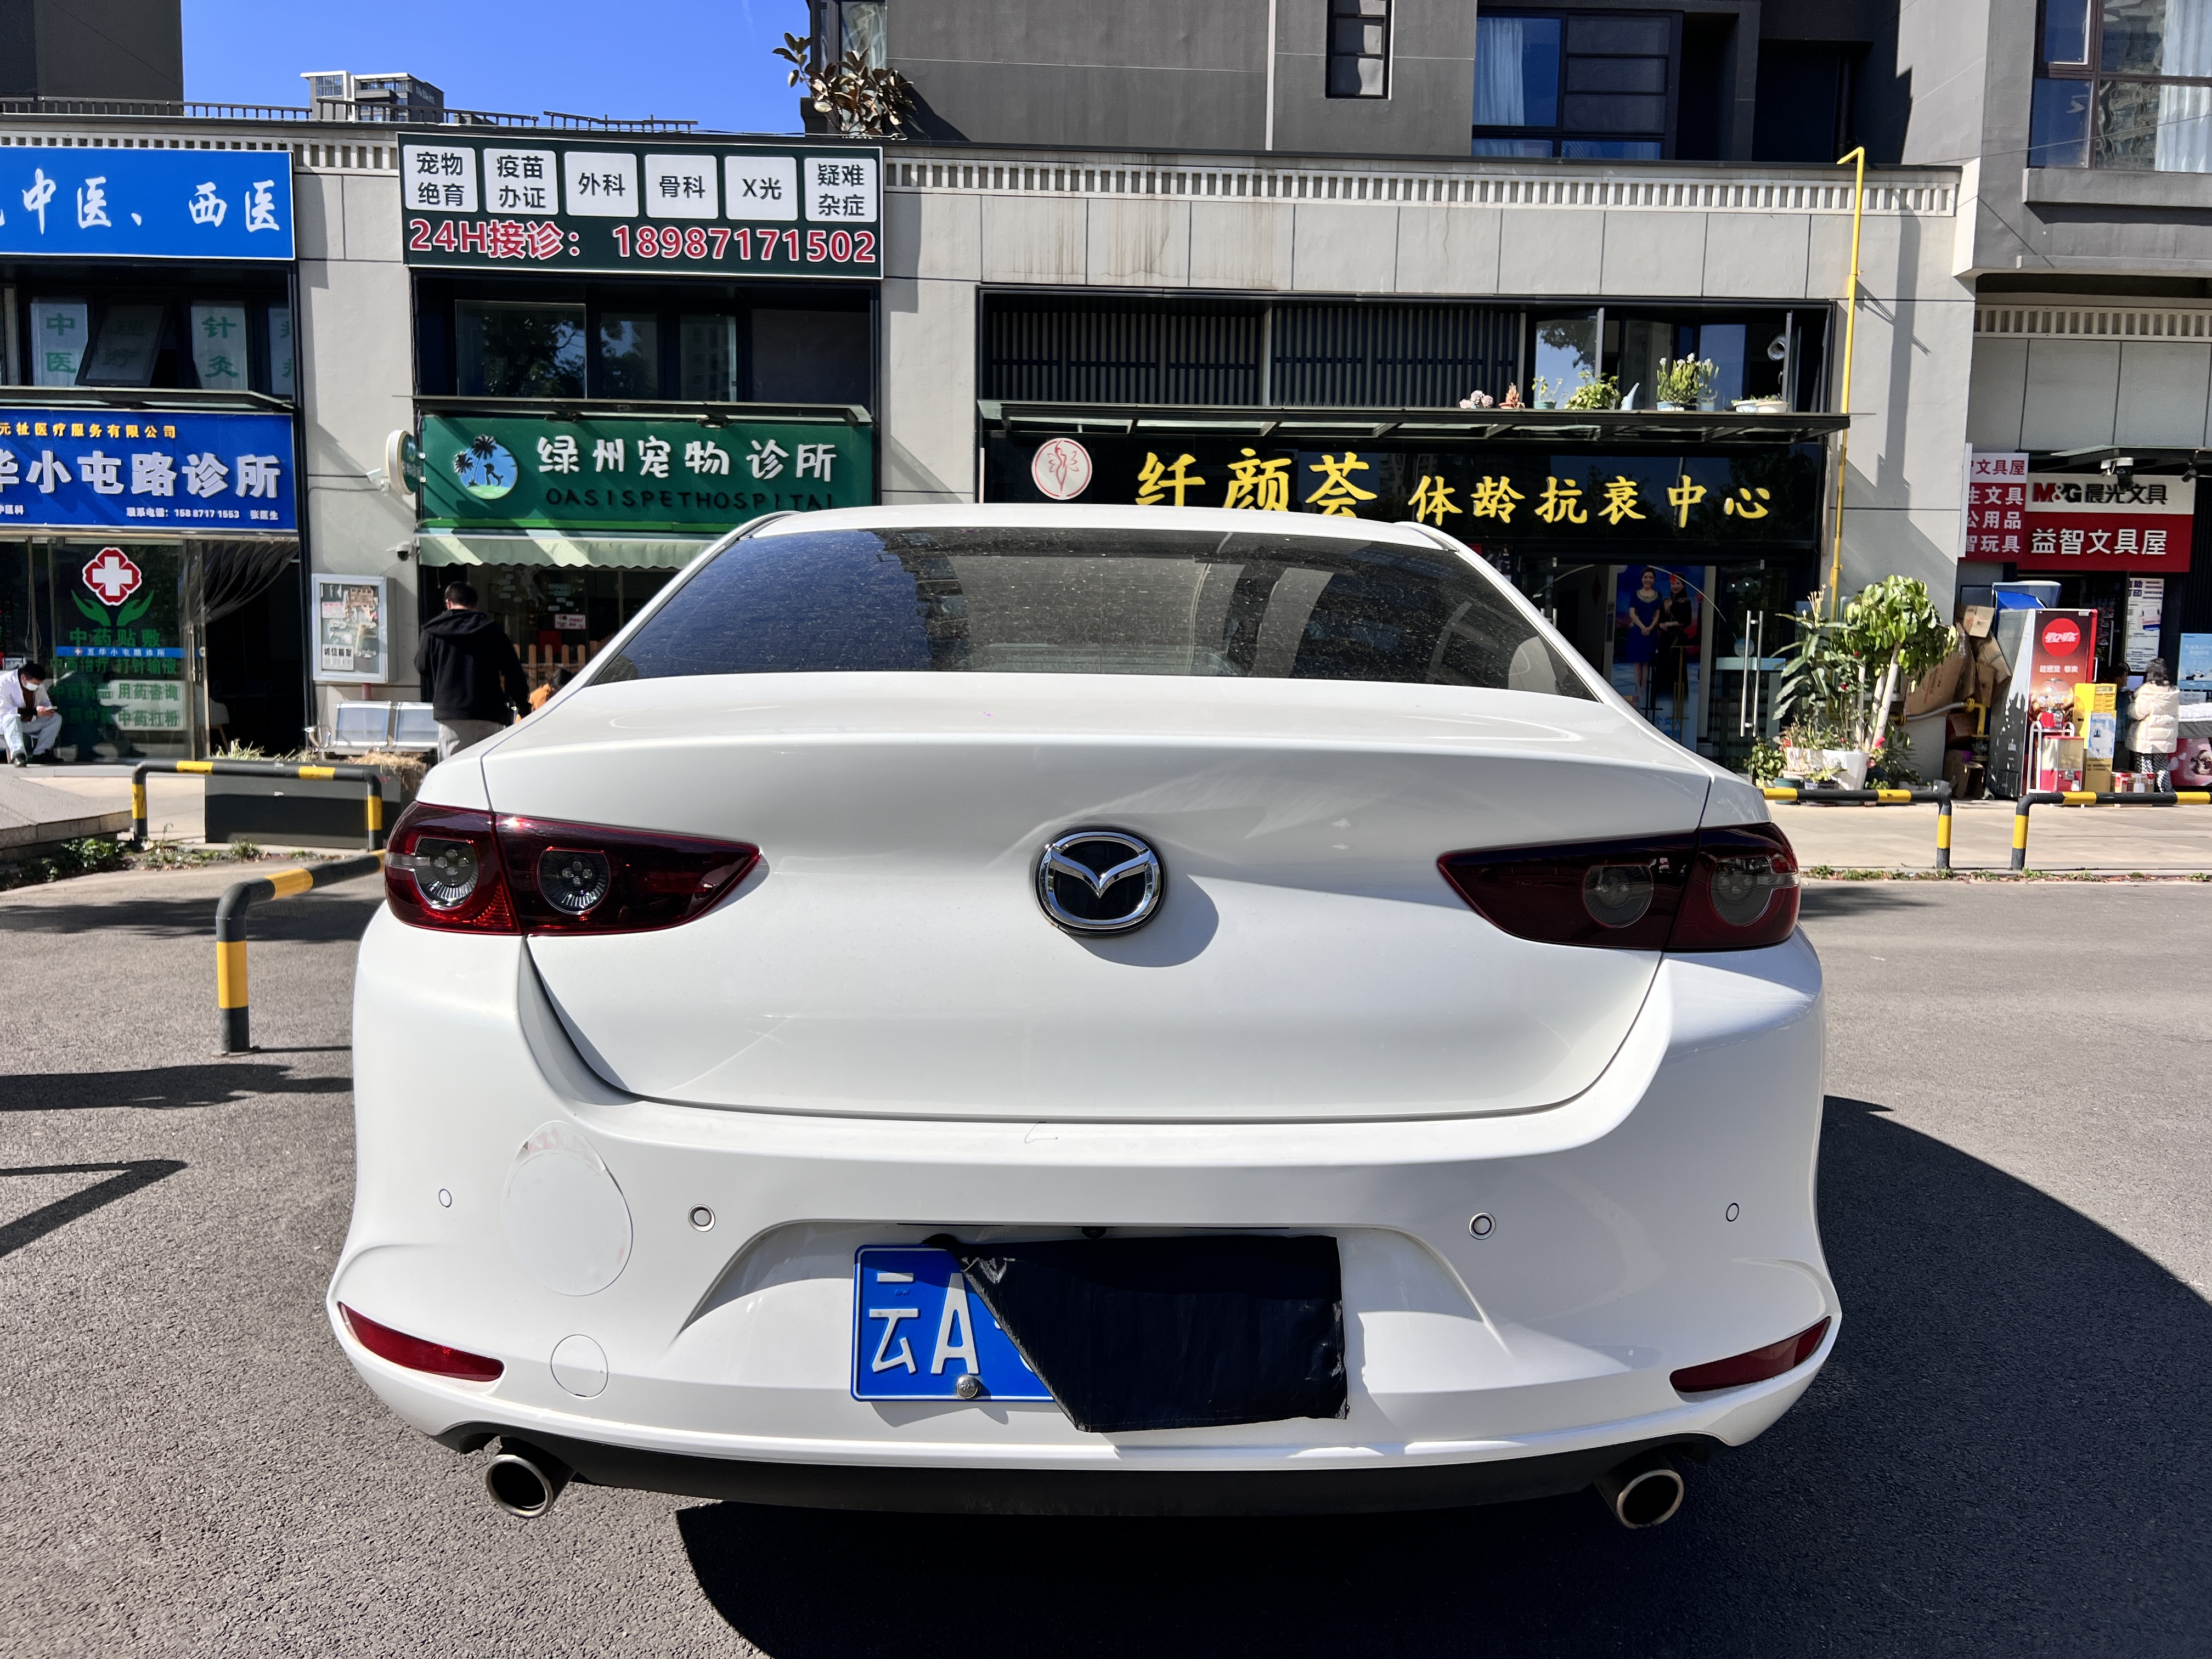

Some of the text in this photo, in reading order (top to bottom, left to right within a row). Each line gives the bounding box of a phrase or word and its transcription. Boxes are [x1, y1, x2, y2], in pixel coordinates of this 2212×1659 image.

[416, 151, 464, 176] 宠物
[497, 155, 543, 179] 疫苗
[817, 164, 865, 187] 疑难
[417, 182, 465, 206] 绝育
[578, 172, 626, 196] 外科
[659, 176, 706, 198] 骨科
[742, 177, 782, 200] X光
[0, 168, 280, 235] 中医、西医
[499, 186, 546, 208] 办证
[818, 193, 865, 217] 杂症
[612, 224, 876, 263] 18987171502
[200, 315, 240, 379] 针灸
[1971, 459, 2025, 476] 文具屋
[1135, 447, 1770, 528] 纤颜荟 体龄抗衰中心
[2032, 482, 2168, 505] M&G 晨光文具
[2031, 528, 2168, 555] 益智文具屋
[868, 1272, 1034, 1374] 云A
